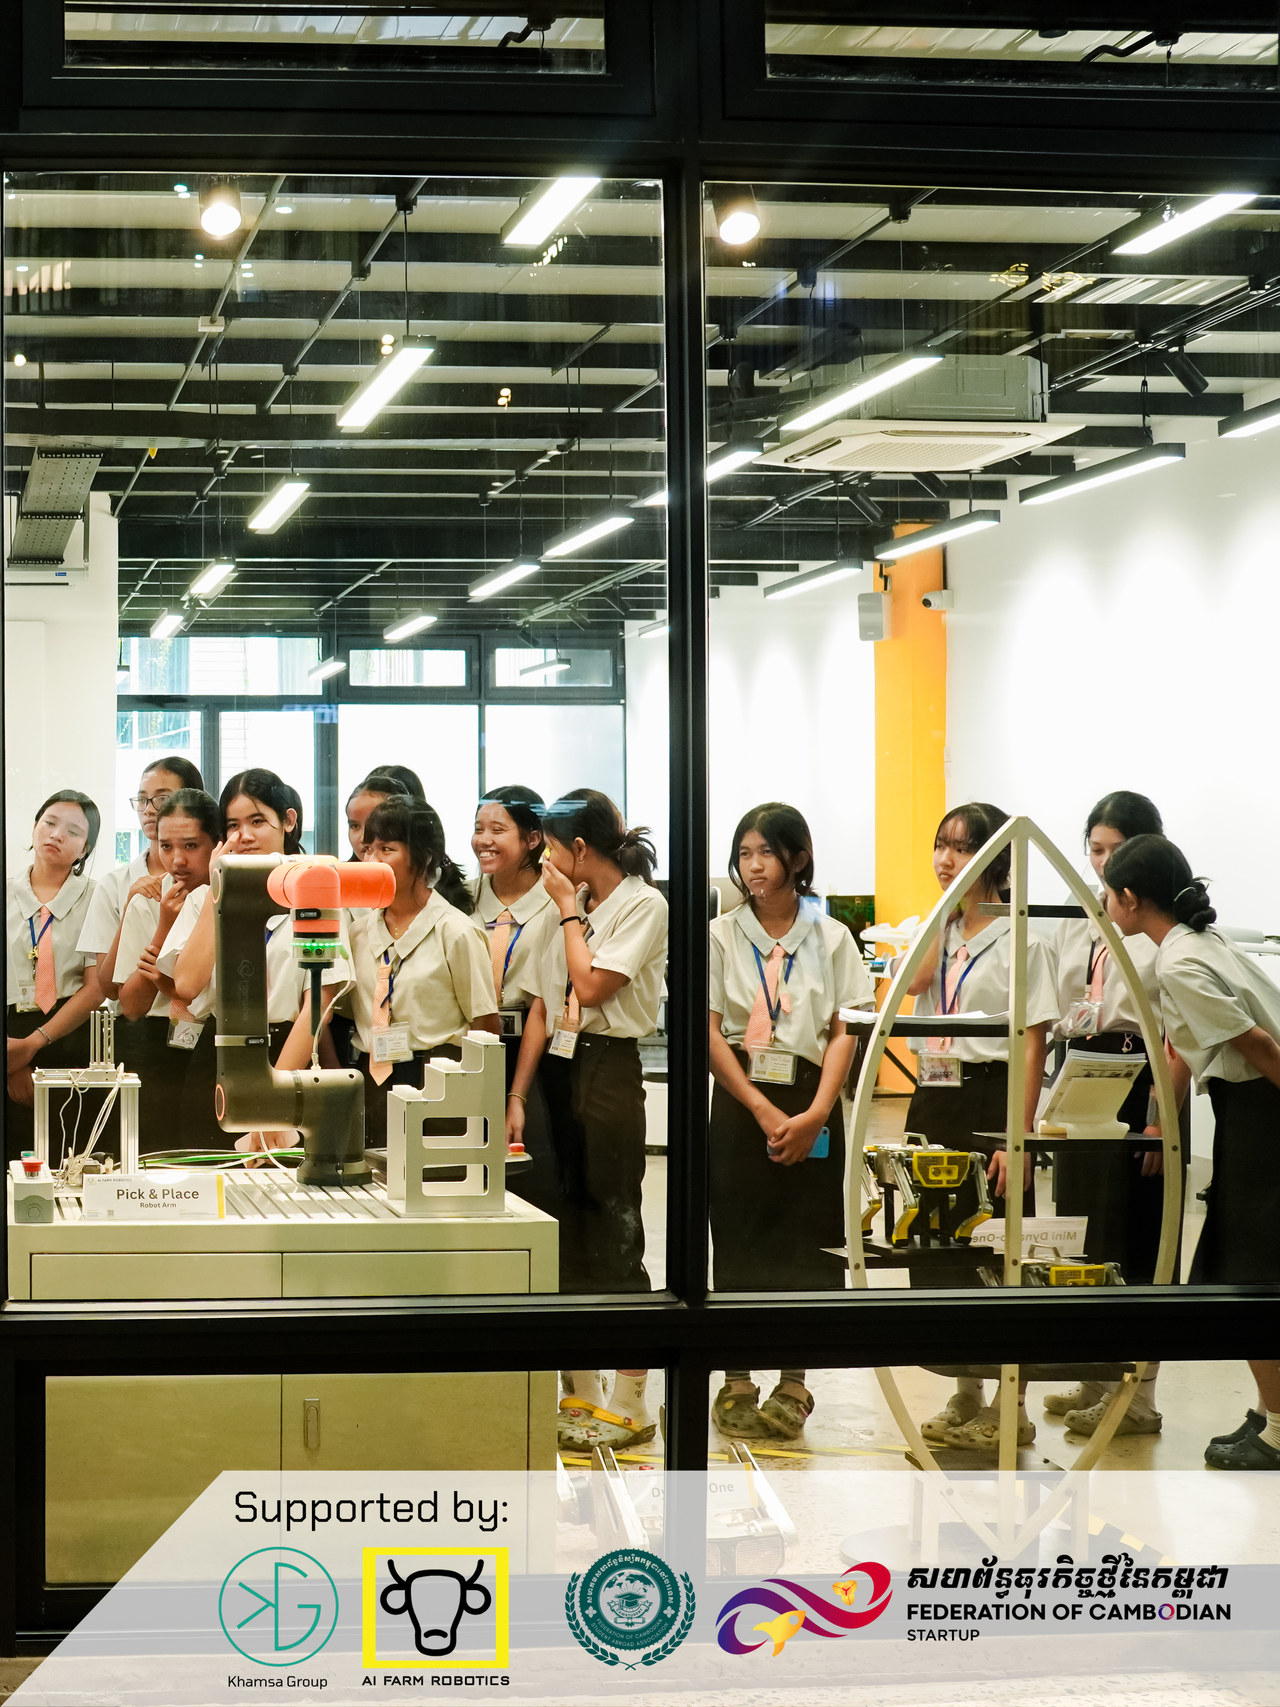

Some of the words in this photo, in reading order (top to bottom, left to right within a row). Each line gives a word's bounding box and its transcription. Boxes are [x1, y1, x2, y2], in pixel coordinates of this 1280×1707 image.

[116, 1188, 145, 1200] Pick
[148, 1189, 158, 1200] &
[161, 1188, 200, 1200] Place
